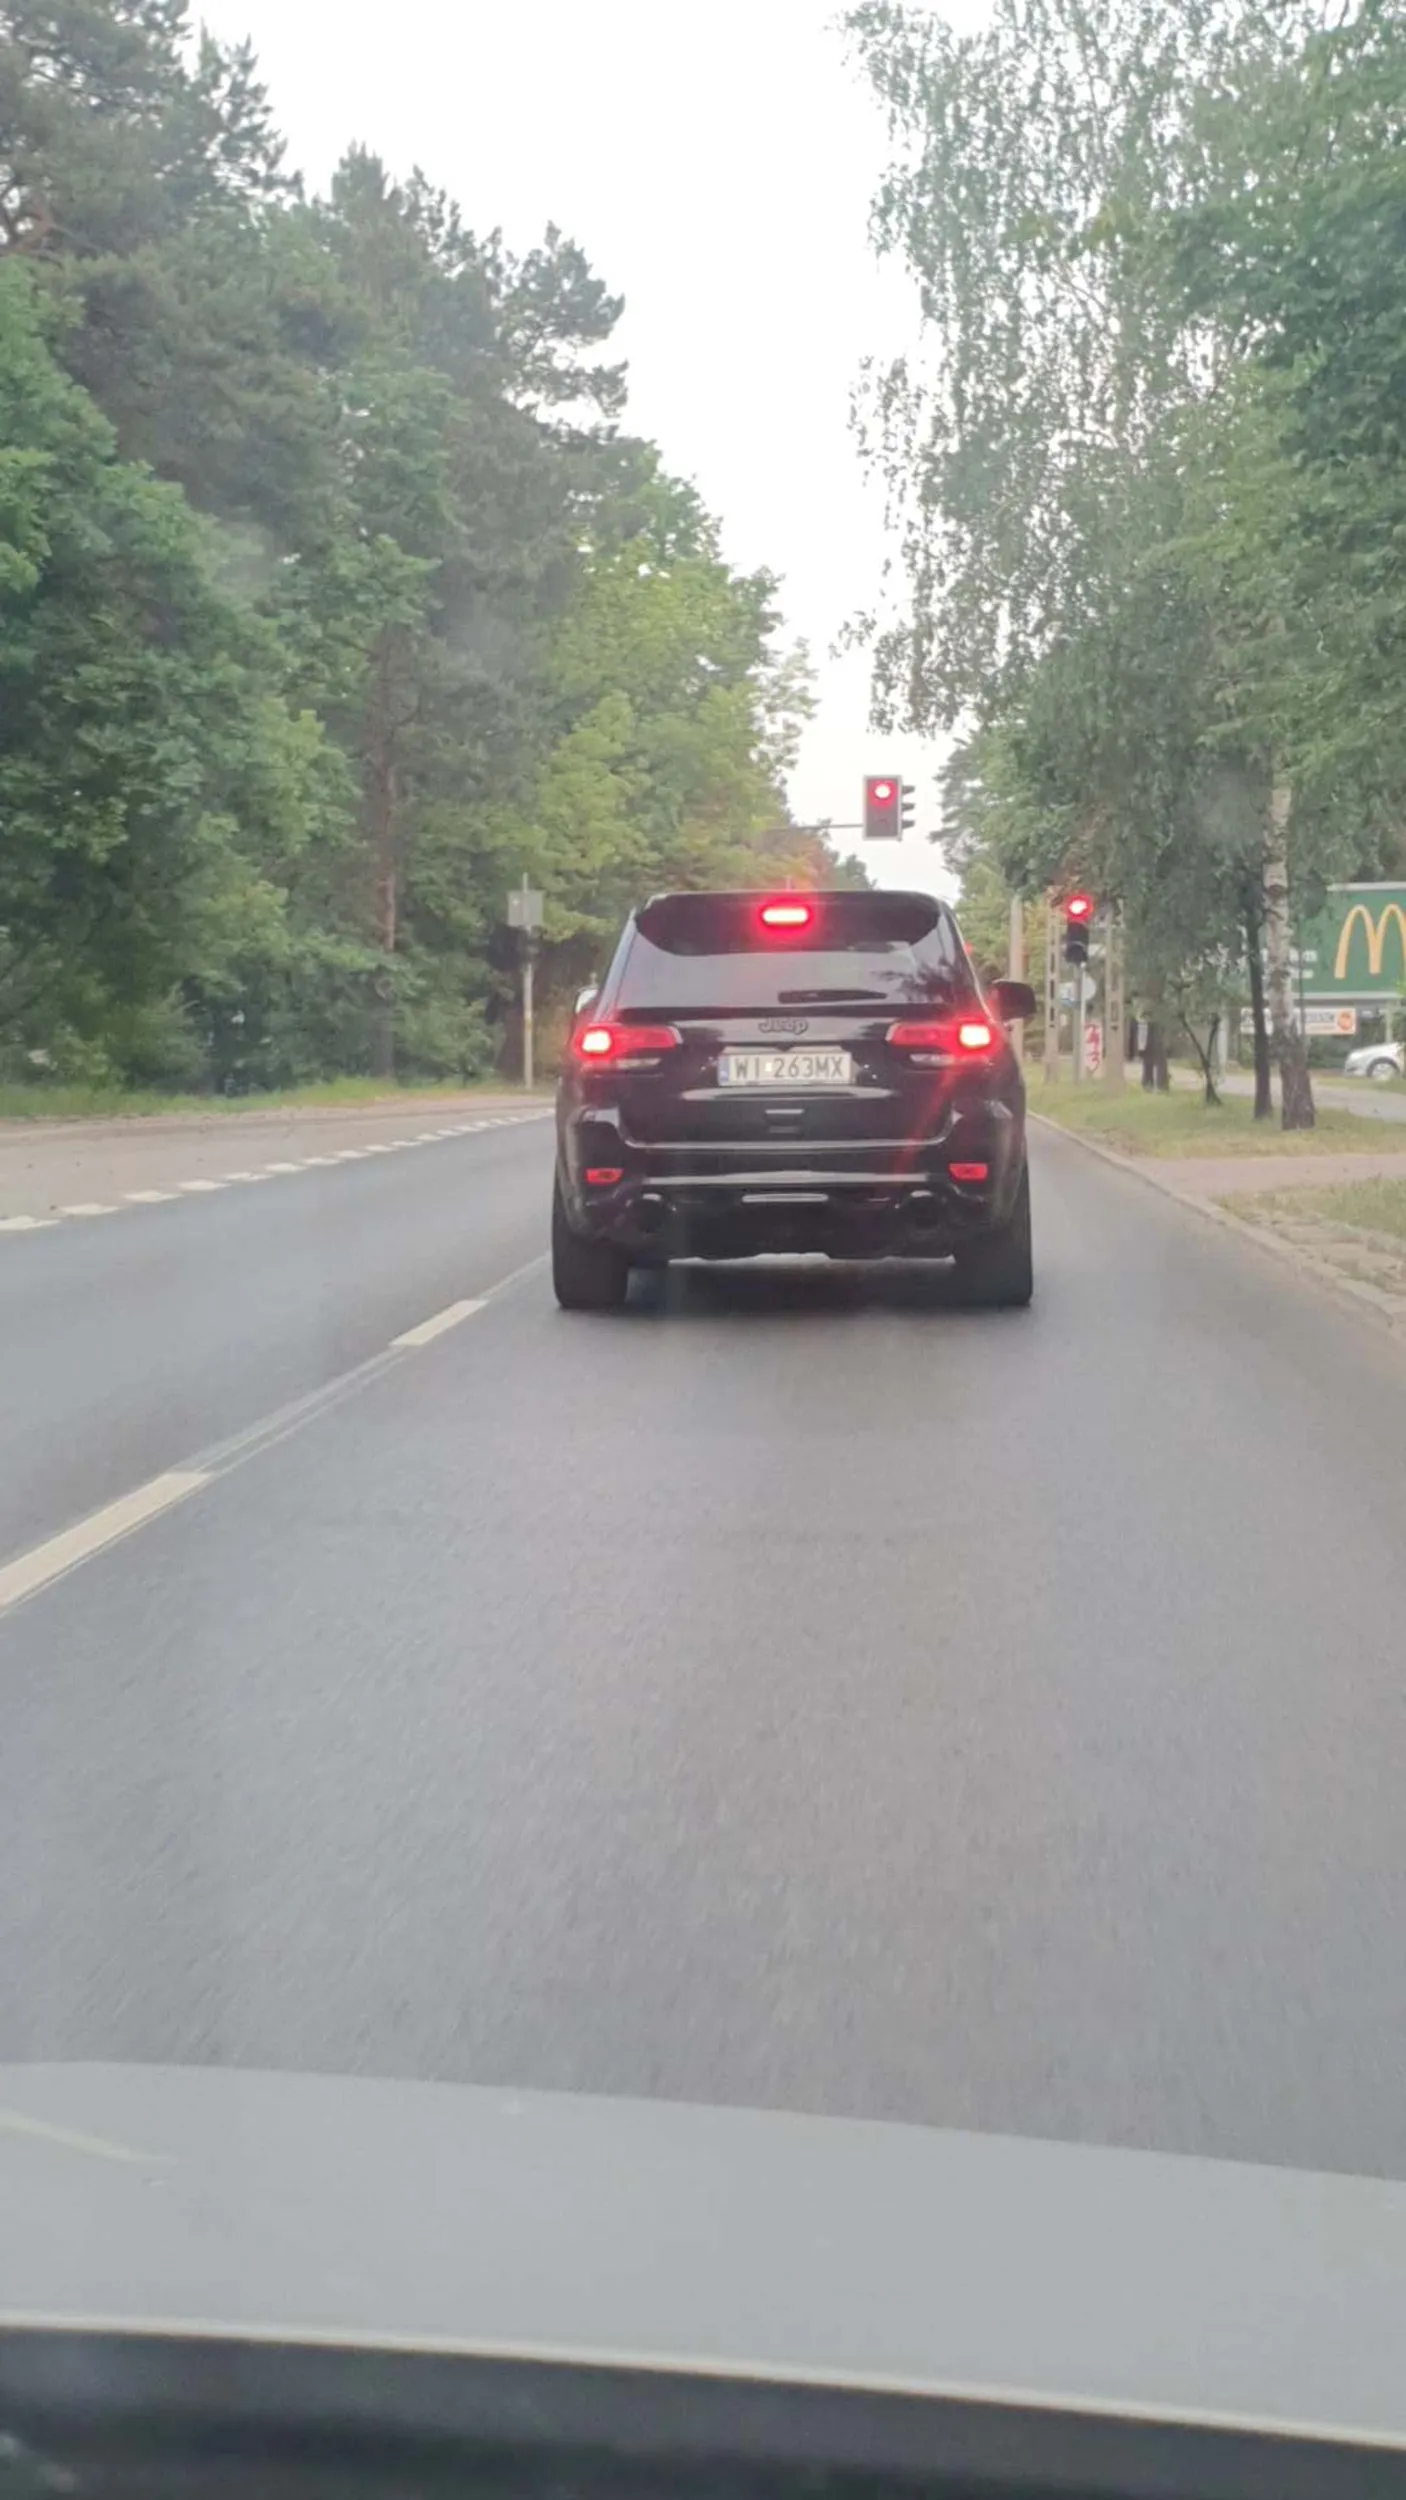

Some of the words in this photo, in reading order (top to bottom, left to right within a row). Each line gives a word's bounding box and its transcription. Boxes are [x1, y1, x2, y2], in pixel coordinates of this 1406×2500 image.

[758, 1017, 809, 1035] Jeep
[734, 1056, 760, 1079] WI
[773, 1056, 844, 1079] 263MX
